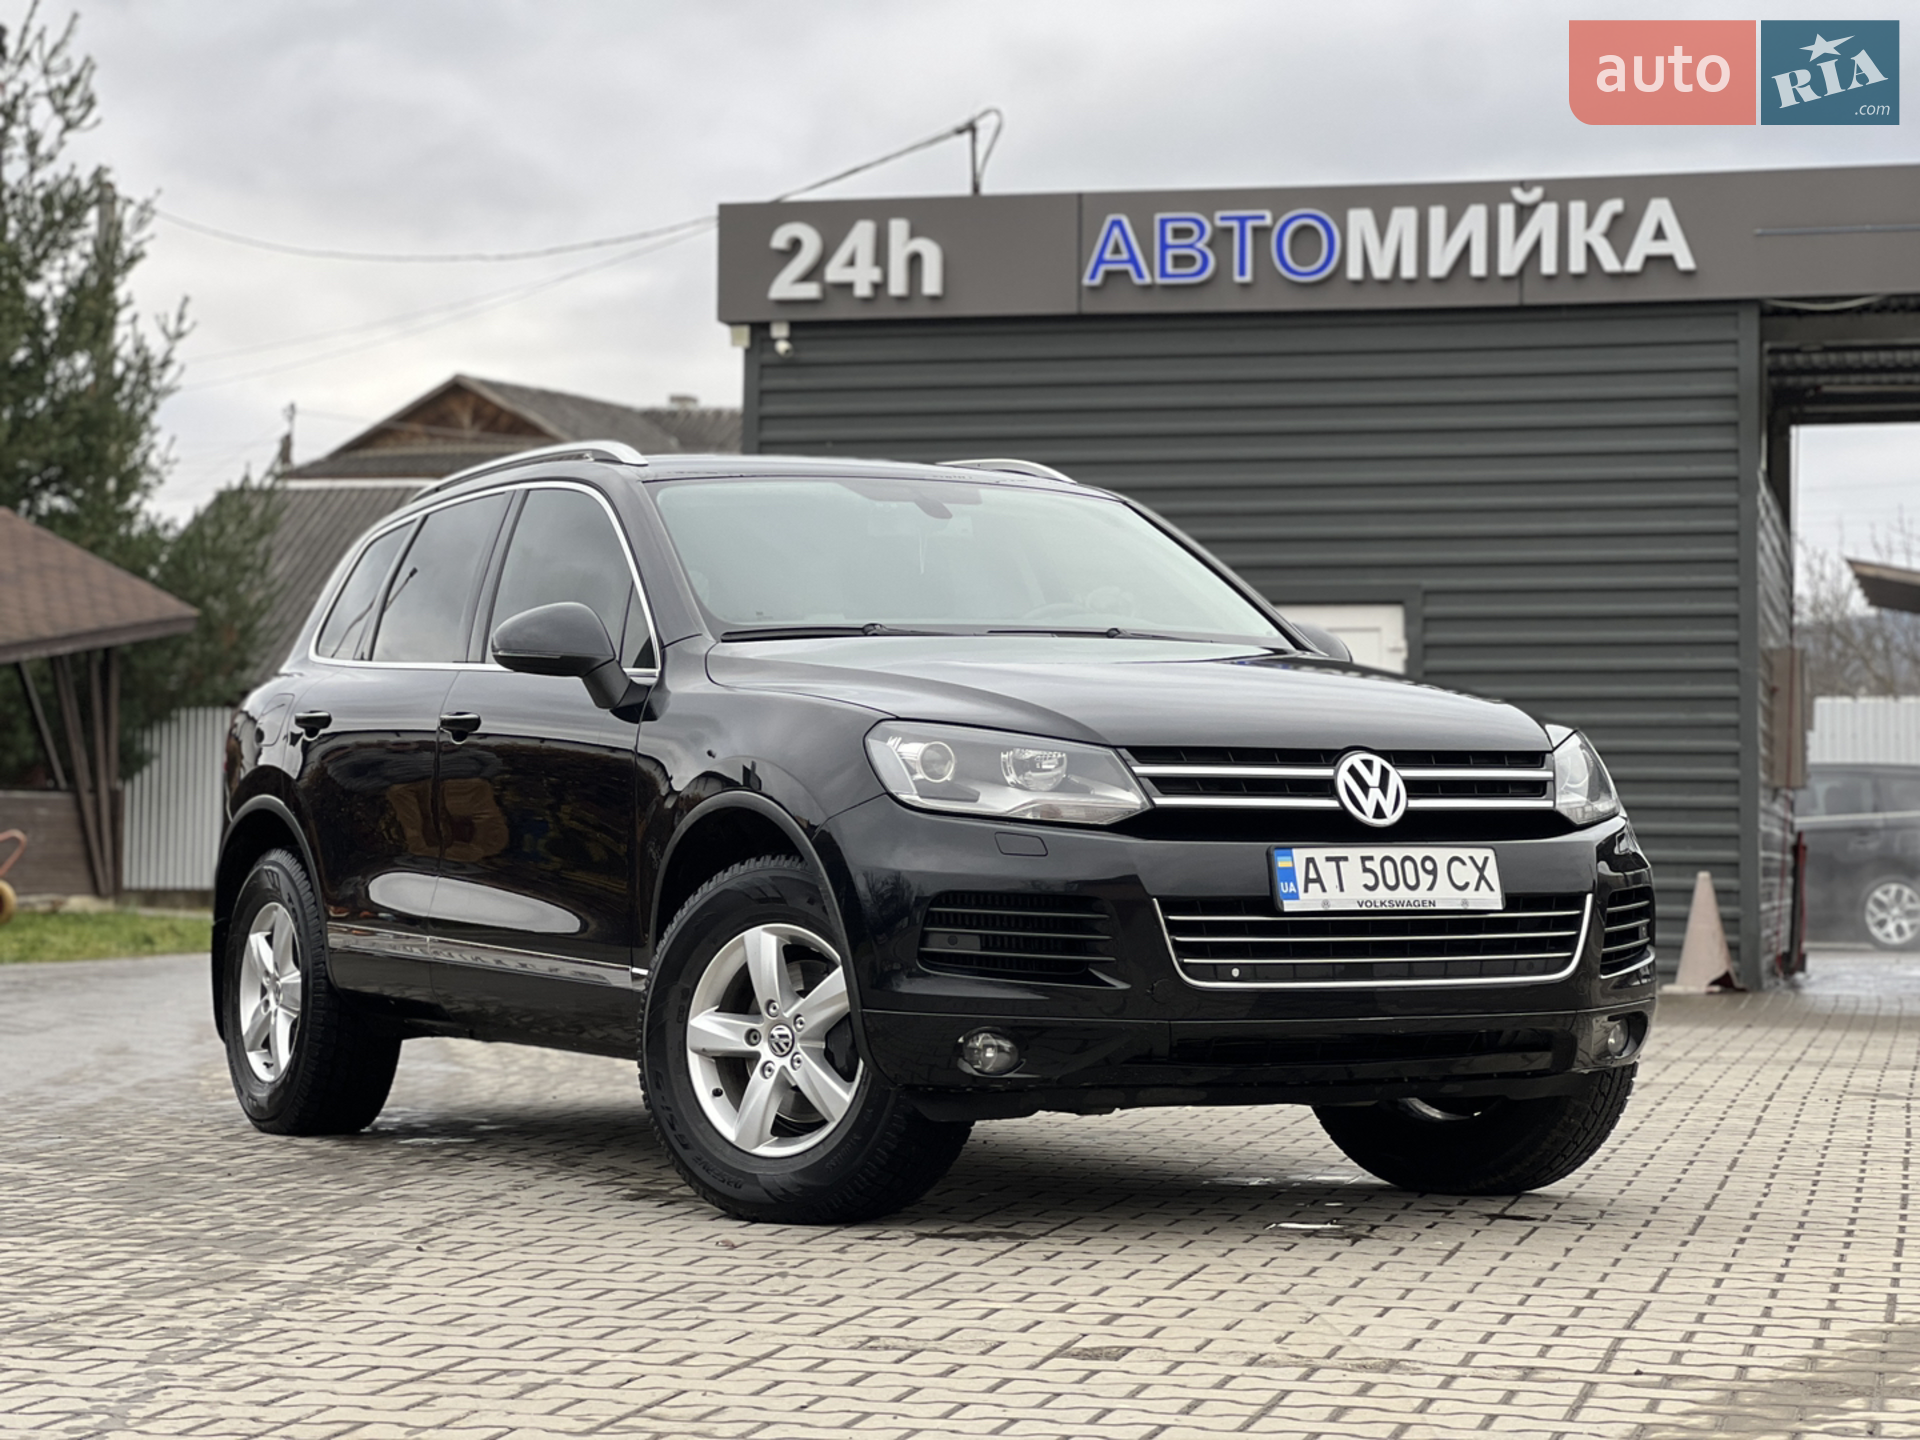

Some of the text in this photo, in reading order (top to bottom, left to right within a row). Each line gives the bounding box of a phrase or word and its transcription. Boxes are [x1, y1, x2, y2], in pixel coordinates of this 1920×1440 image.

[767, 217, 945, 302] 24h
[1083, 186, 1697, 286] АВТОМИЙКА
[1336, 751, 1407, 826] VW
[1280, 881, 1297, 893] UA
[1303, 855, 1495, 893] AT 5009 CX
[1356, 899, 1437, 909] VOLKSWAGEN
